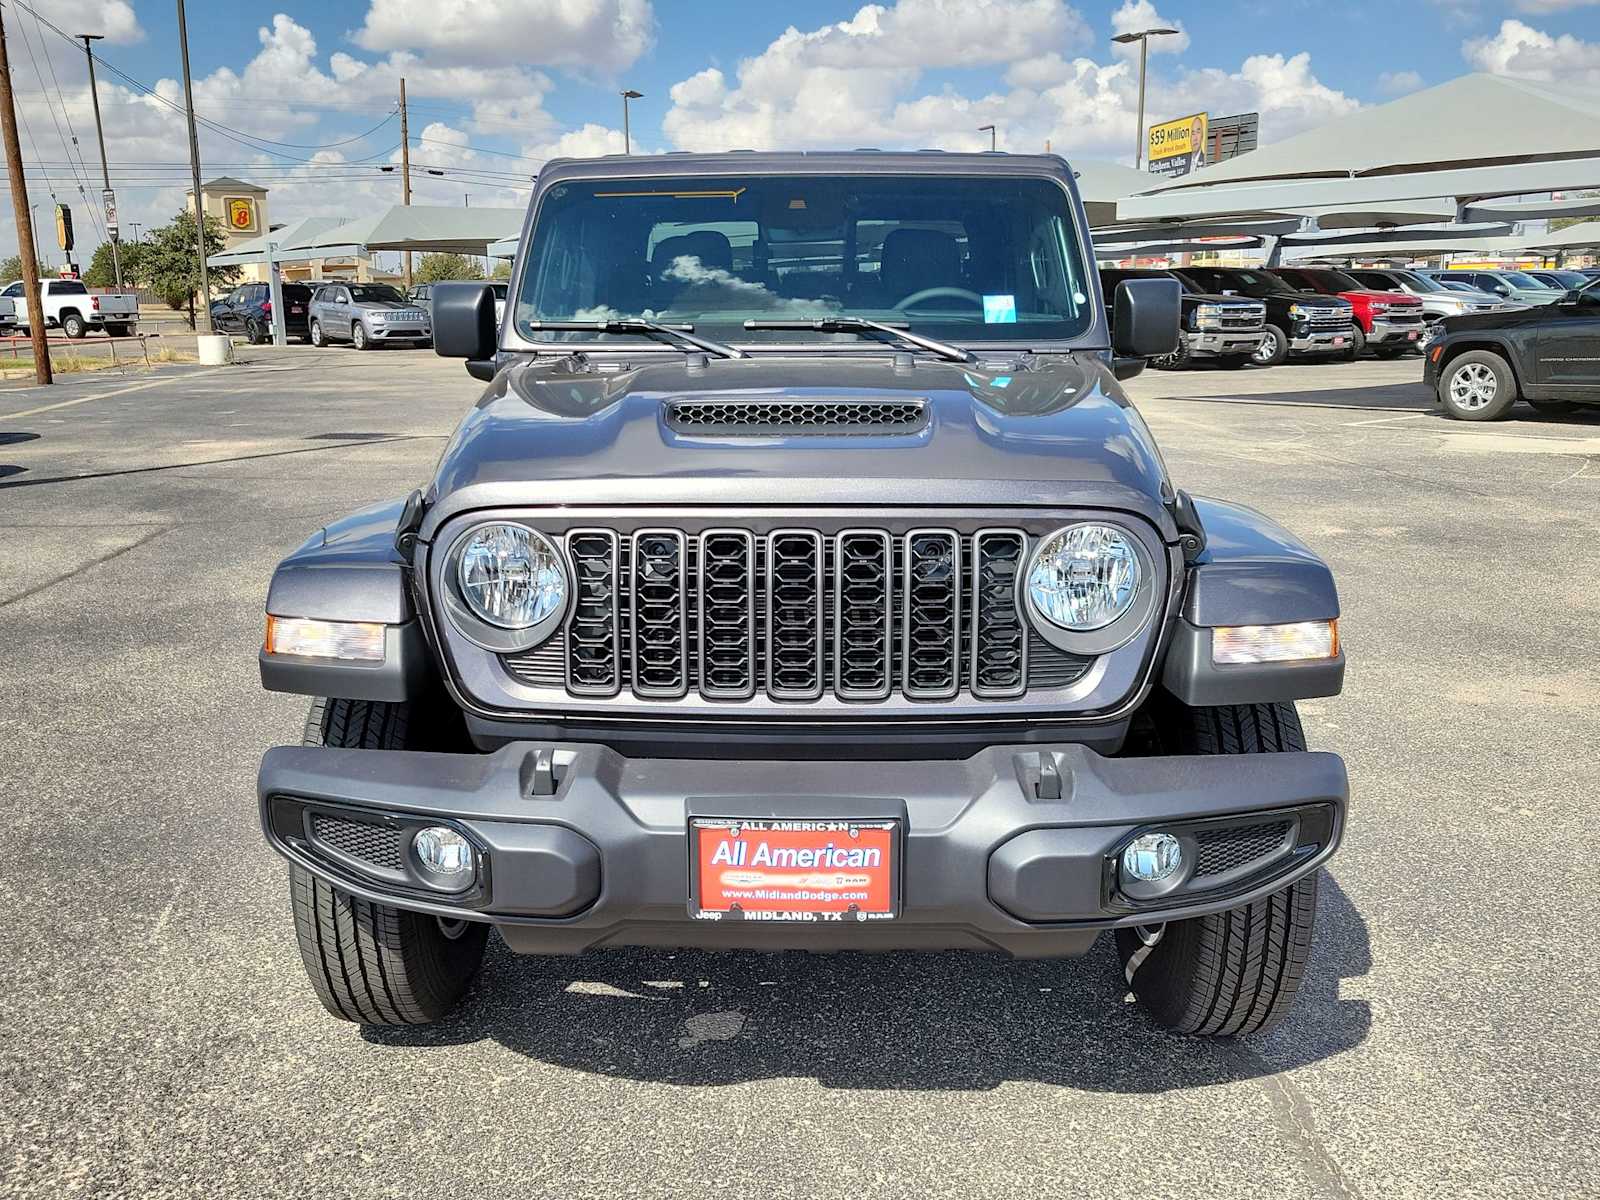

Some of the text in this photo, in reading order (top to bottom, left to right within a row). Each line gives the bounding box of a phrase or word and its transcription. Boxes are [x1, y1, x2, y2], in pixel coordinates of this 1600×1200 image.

[1150, 127, 1190, 145] $59 Million
[236, 210, 248, 225] 8
[741, 821, 768, 831] ALL
[711, 840, 881, 868] All American
[721, 889, 868, 901] www.MidlandDodge.com
[696, 910, 722, 921] Jeep
[744, 911, 843, 922] MIDLAND, TX
